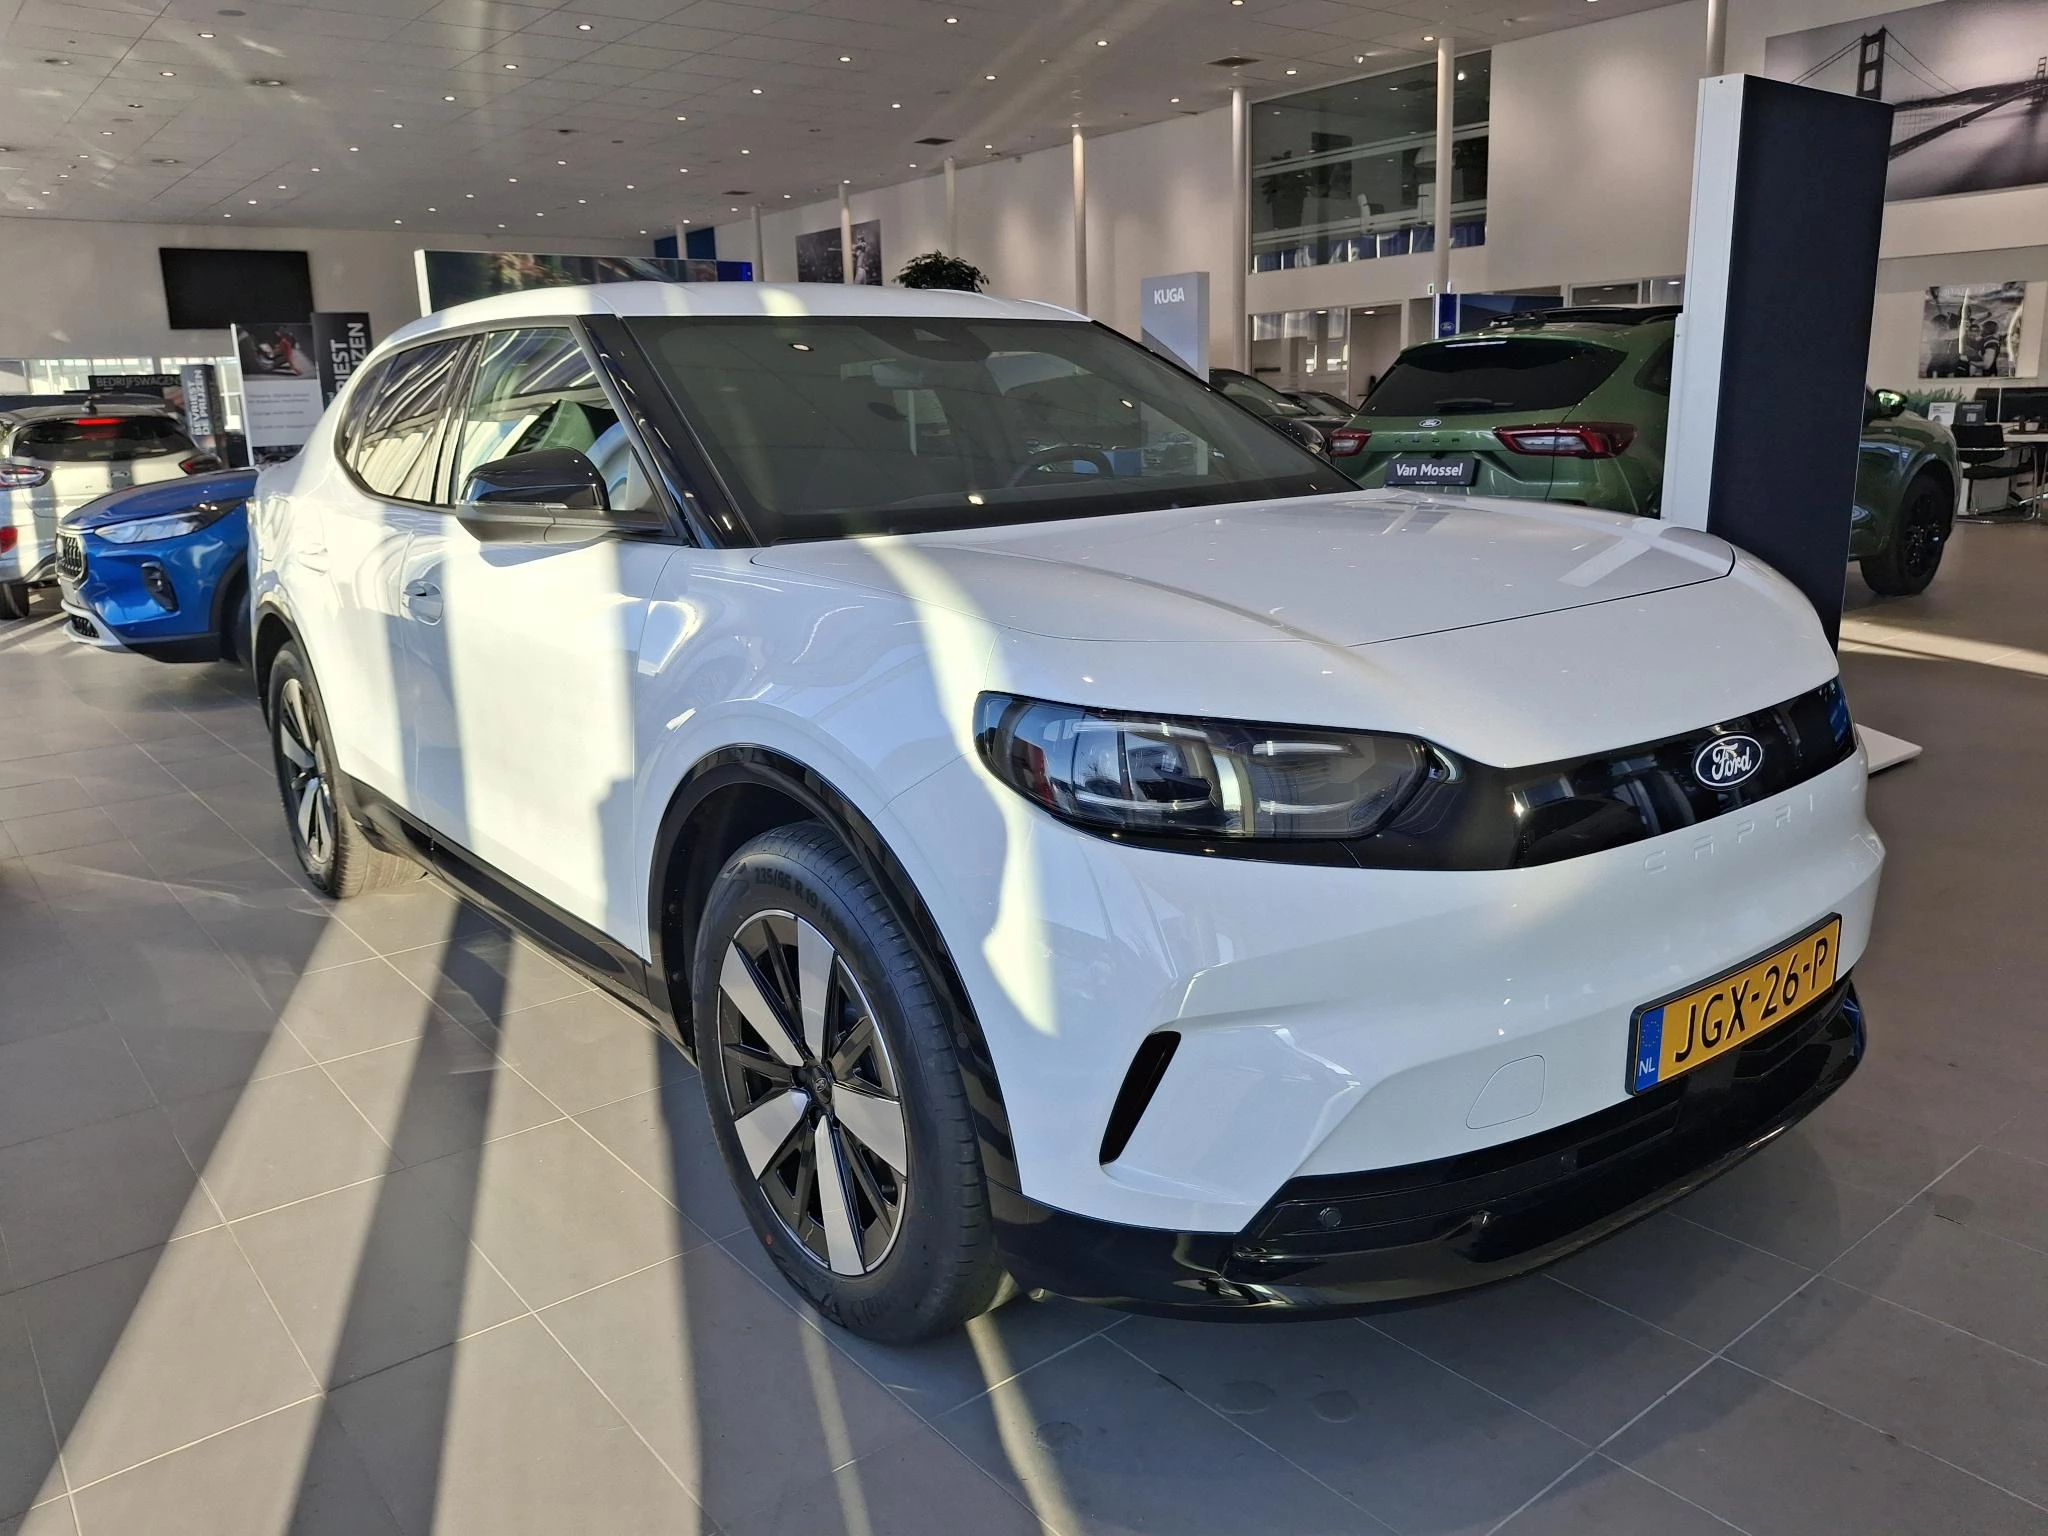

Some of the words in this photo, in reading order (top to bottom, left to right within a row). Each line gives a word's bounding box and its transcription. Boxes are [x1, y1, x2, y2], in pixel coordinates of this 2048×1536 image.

[1153, 287, 1185, 305] KUGA
[200, 419, 211, 436] DE
[1396, 463, 1418, 476] Van
[1420, 462, 1464, 477] Mossel
[1710, 741, 1753, 781] Ford
[1643, 793, 1814, 874] CAPRI
[1674, 937, 1829, 1063] JGX-26-P
[1639, 1060, 1656, 1077] NL
